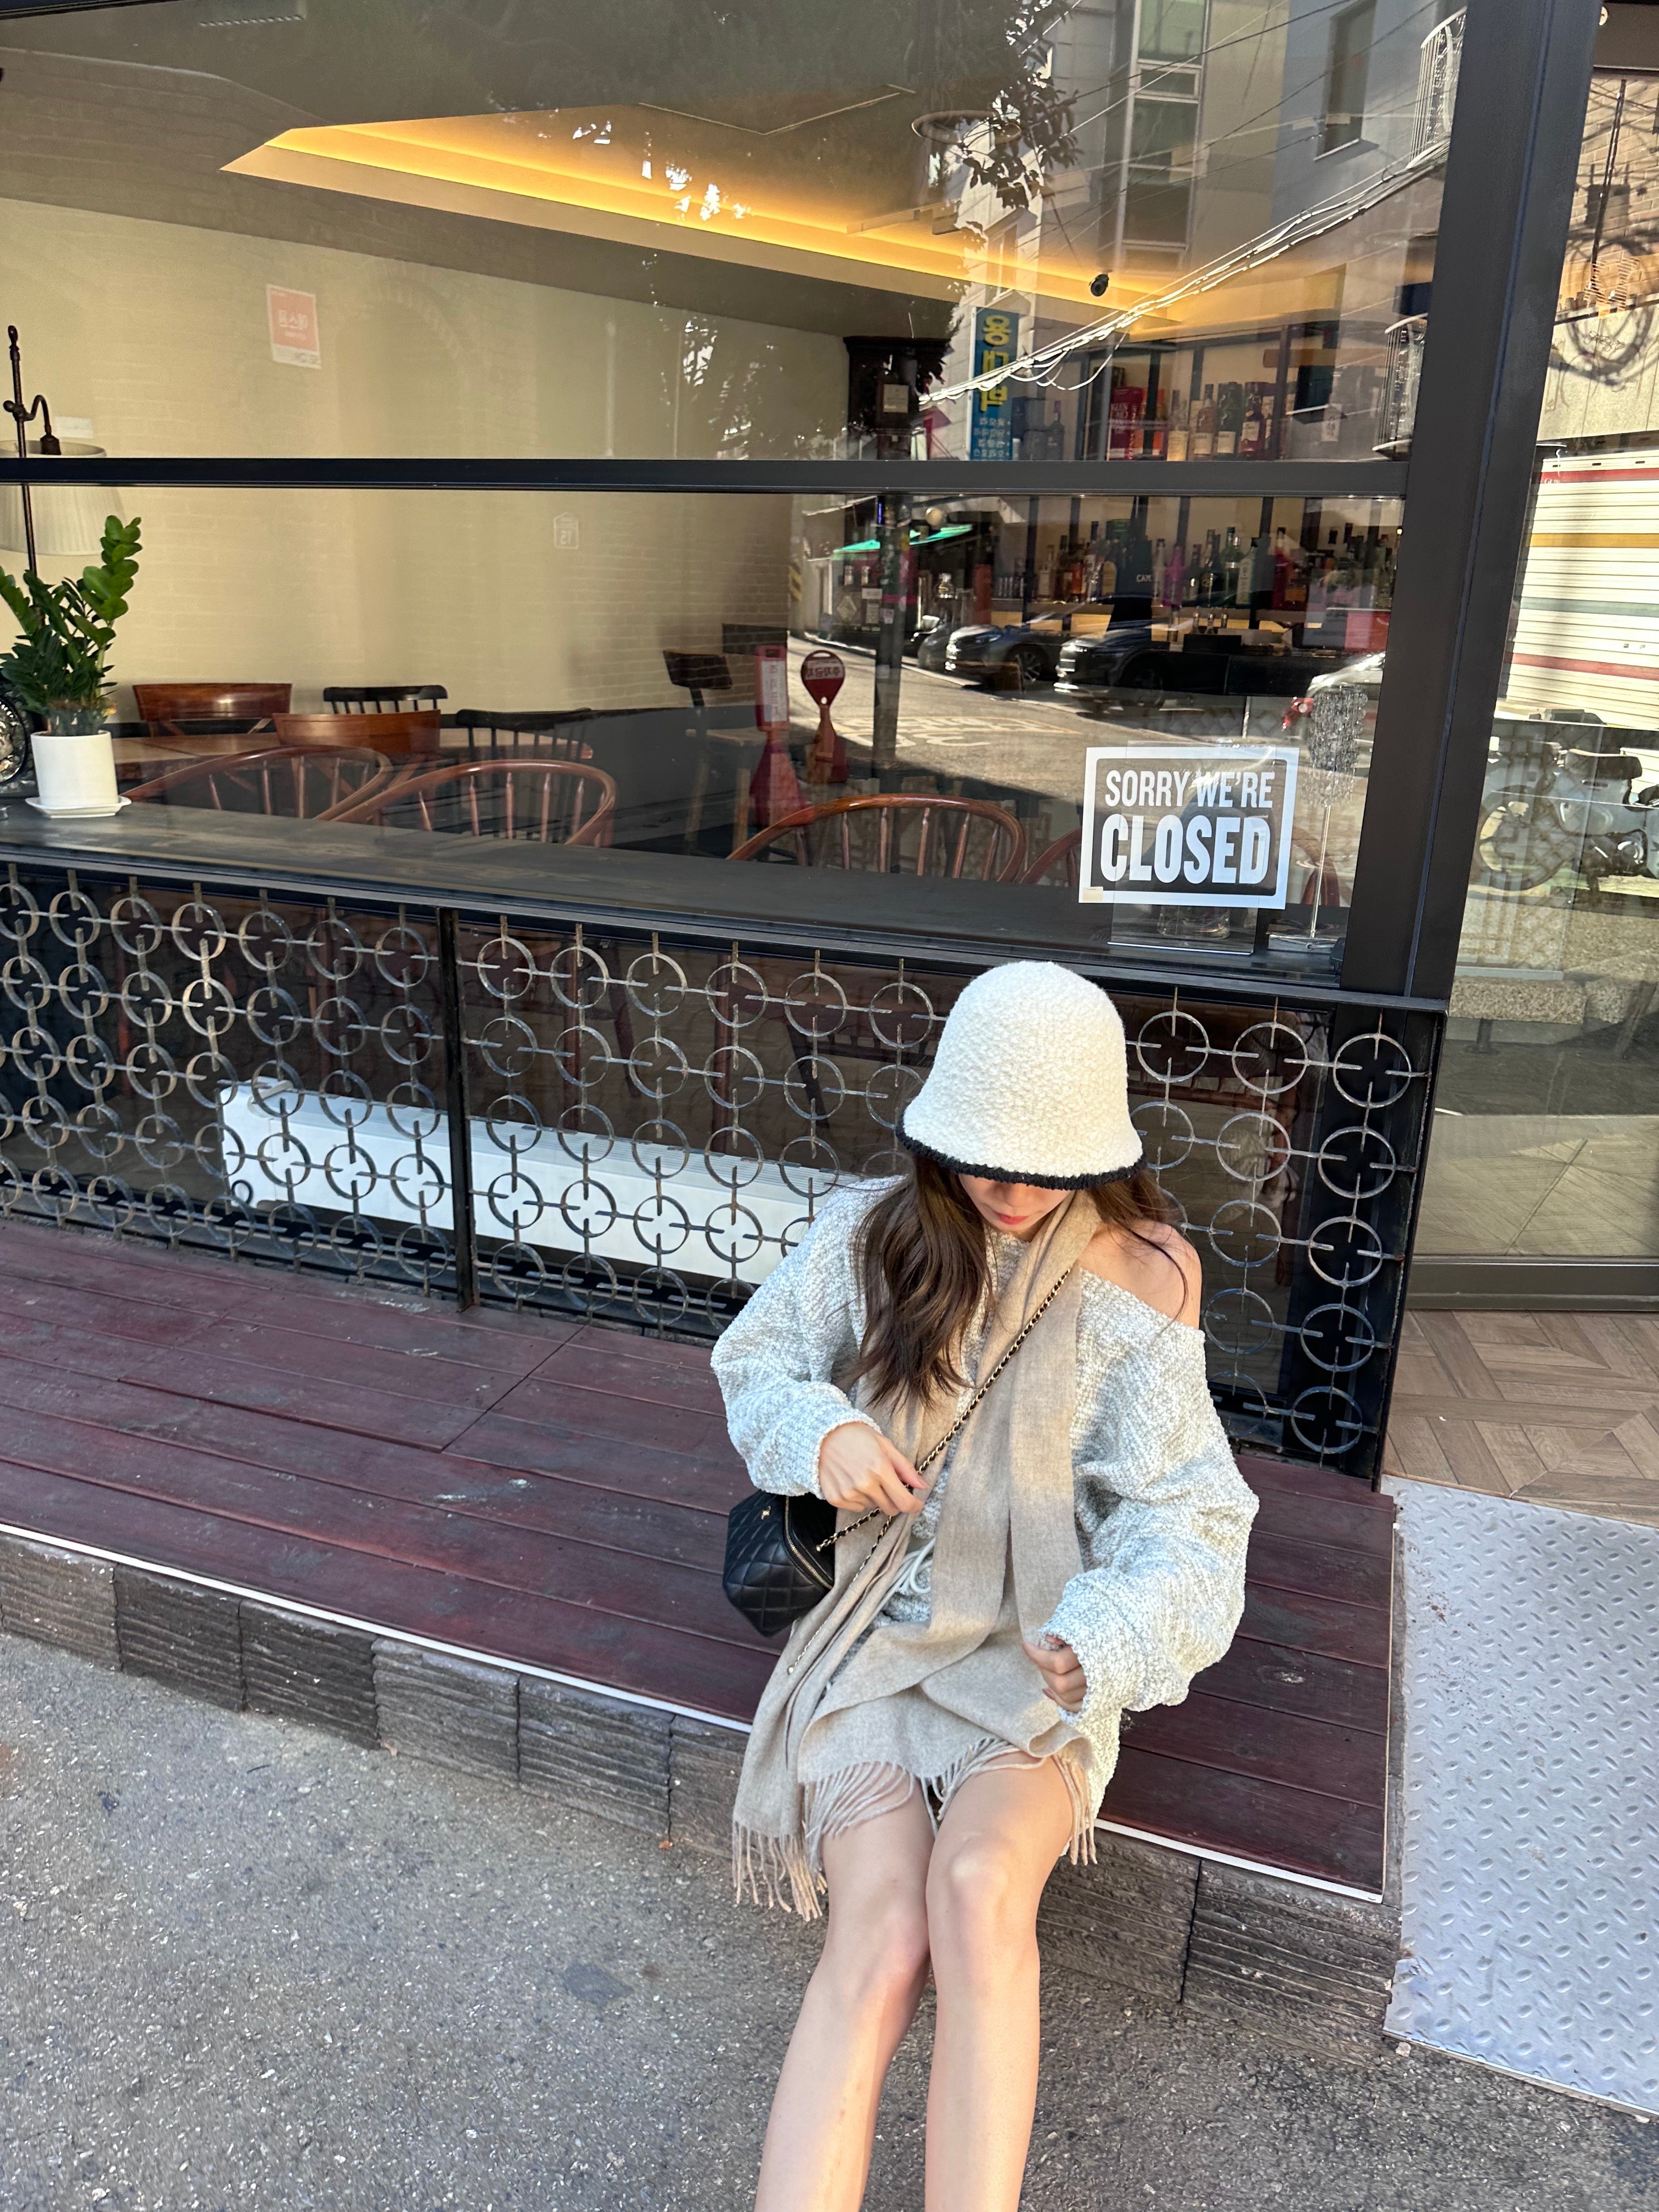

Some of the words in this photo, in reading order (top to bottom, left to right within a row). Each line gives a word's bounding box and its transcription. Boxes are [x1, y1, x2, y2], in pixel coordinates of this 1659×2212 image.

[1105, 770, 1190, 807] SORRY
[1195, 771, 1276, 808] WE'RE
[1101, 814, 1271, 884] CLOSED
